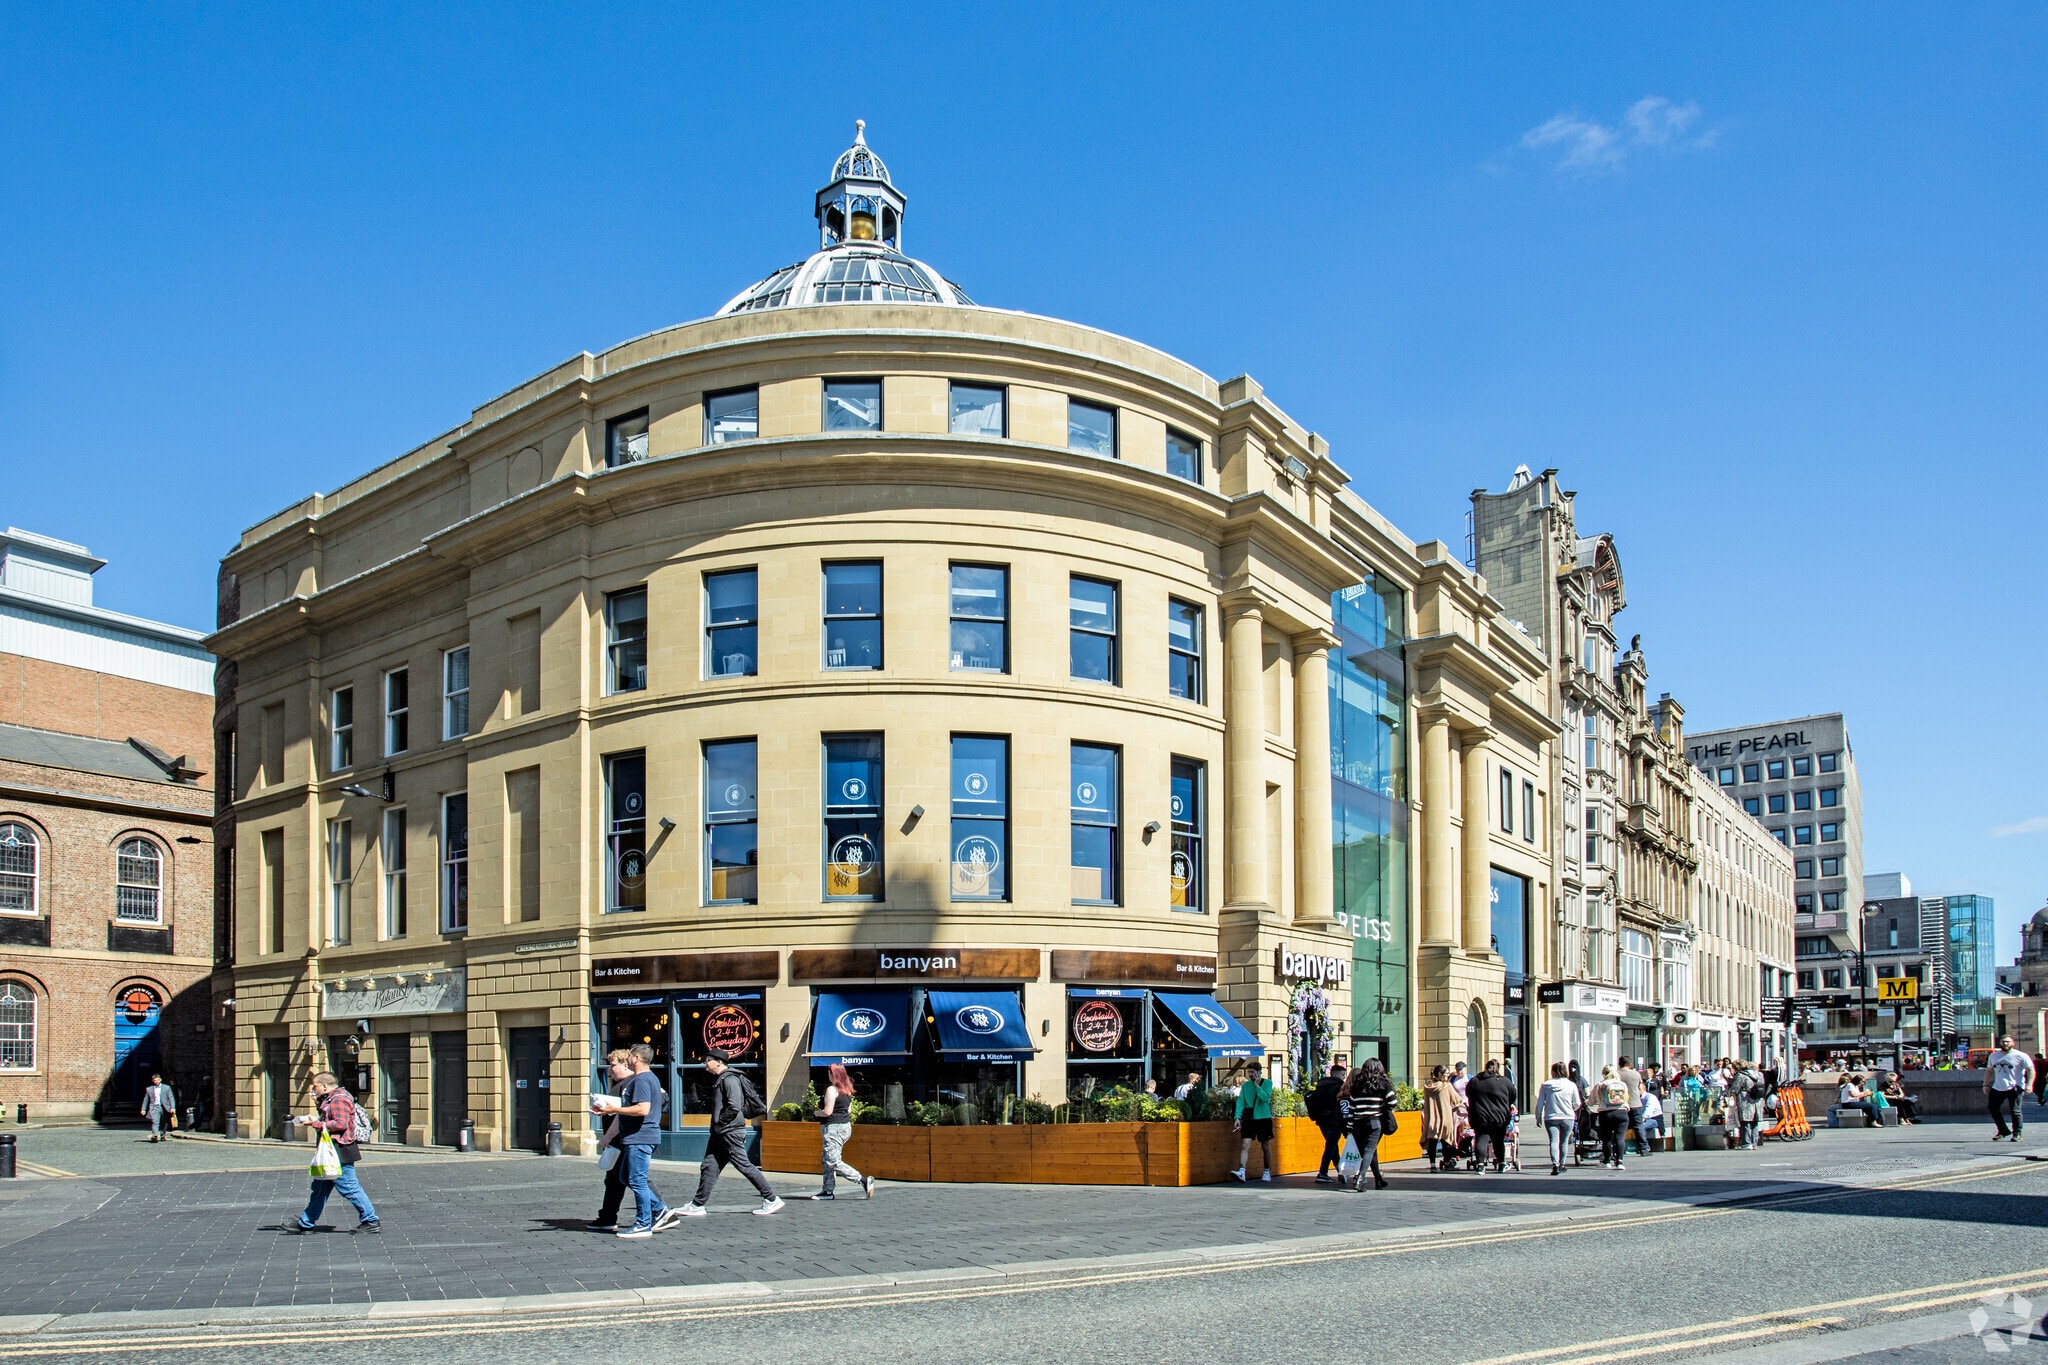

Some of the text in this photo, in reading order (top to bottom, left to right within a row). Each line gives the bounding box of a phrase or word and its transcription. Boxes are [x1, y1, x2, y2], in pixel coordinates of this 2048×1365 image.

[1690, 730, 1812, 760] THE PEARL
[1336, 911, 1391, 943] REISS
[880, 953, 957, 973] banyan
[1176, 963, 1215, 974] Bar & Kitchen
[1279, 942, 1348, 986] banyan
[595, 967, 641, 977] Bar & Kitchen
[1509, 987, 1523, 999] BOSS
[1885, 981, 1909, 997] M
[617, 997, 641, 1006] banyan
[708, 1015, 746, 1029] Cocktails
[1080, 1010, 1115, 1023] Cocktails
[715, 1026, 740, 1038] 2-4-1
[1086, 1020, 1109, 1031] 2-4-1
[709, 1033, 749, 1048] Everyday
[1082, 1028, 1117, 1042] Everyday
[841, 1056, 874, 1065] banyan
